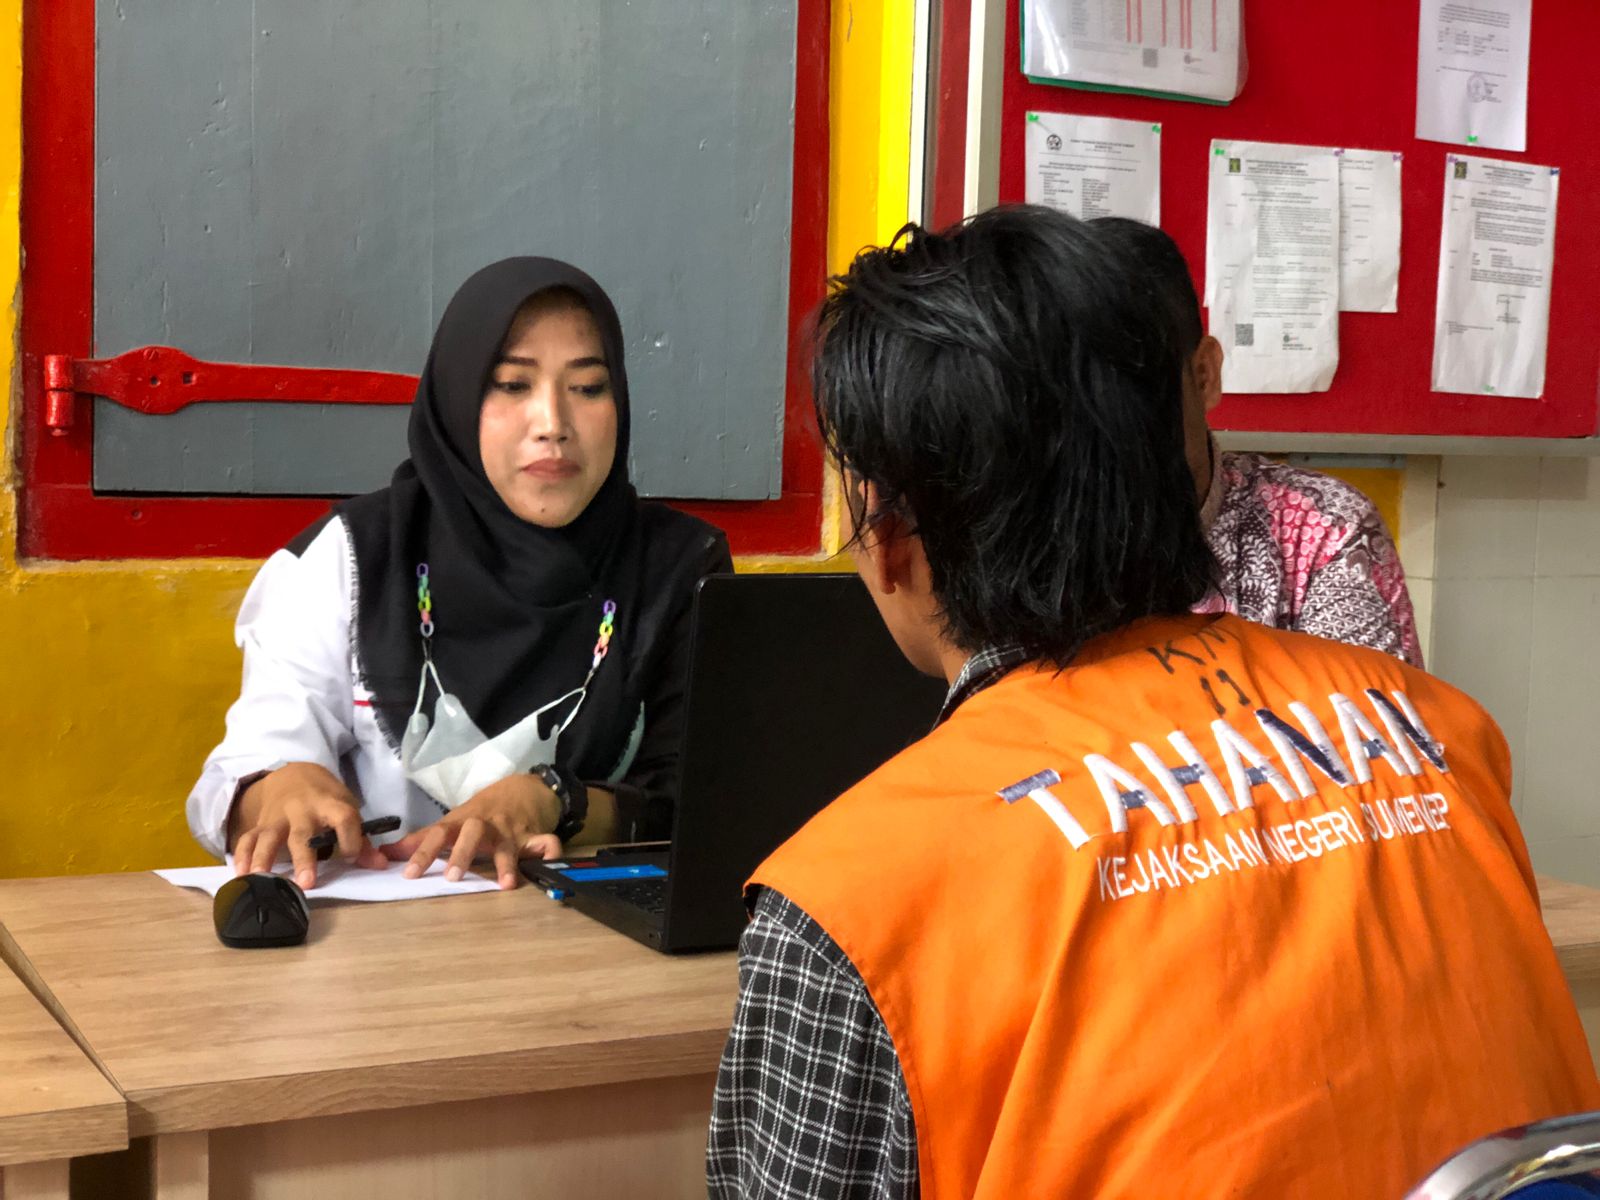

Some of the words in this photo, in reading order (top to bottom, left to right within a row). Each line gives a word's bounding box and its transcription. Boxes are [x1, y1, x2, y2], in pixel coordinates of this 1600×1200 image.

[996, 688, 1449, 850] TAHANAN
[1098, 827, 1269, 901] KEJAKSAAN
[1262, 806, 1364, 864] NEGERI
[1360, 792, 1450, 842] SUMENEP
